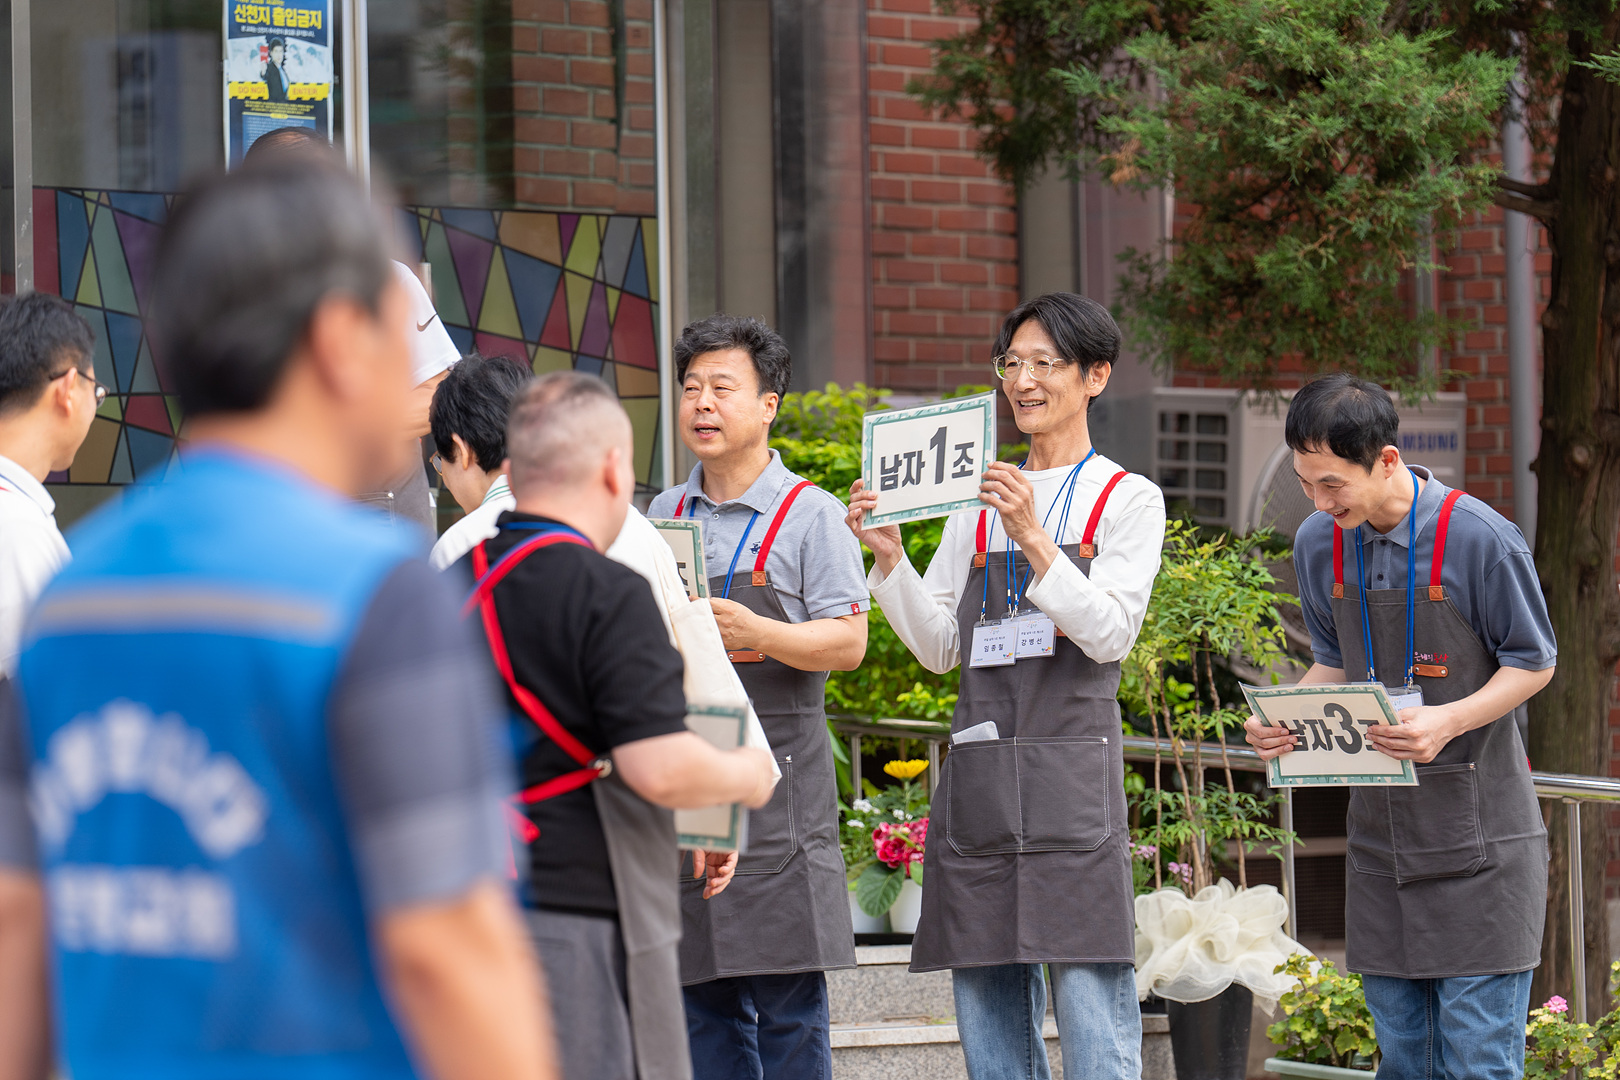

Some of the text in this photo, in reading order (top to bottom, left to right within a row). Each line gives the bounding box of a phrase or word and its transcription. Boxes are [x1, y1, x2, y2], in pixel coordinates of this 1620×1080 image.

[234, 4, 322, 29] 신천지 출입금지
[238, 86, 249, 94] DO
[292, 87, 318, 95] ENTER
[1399, 432, 1458, 452] MSUNG
